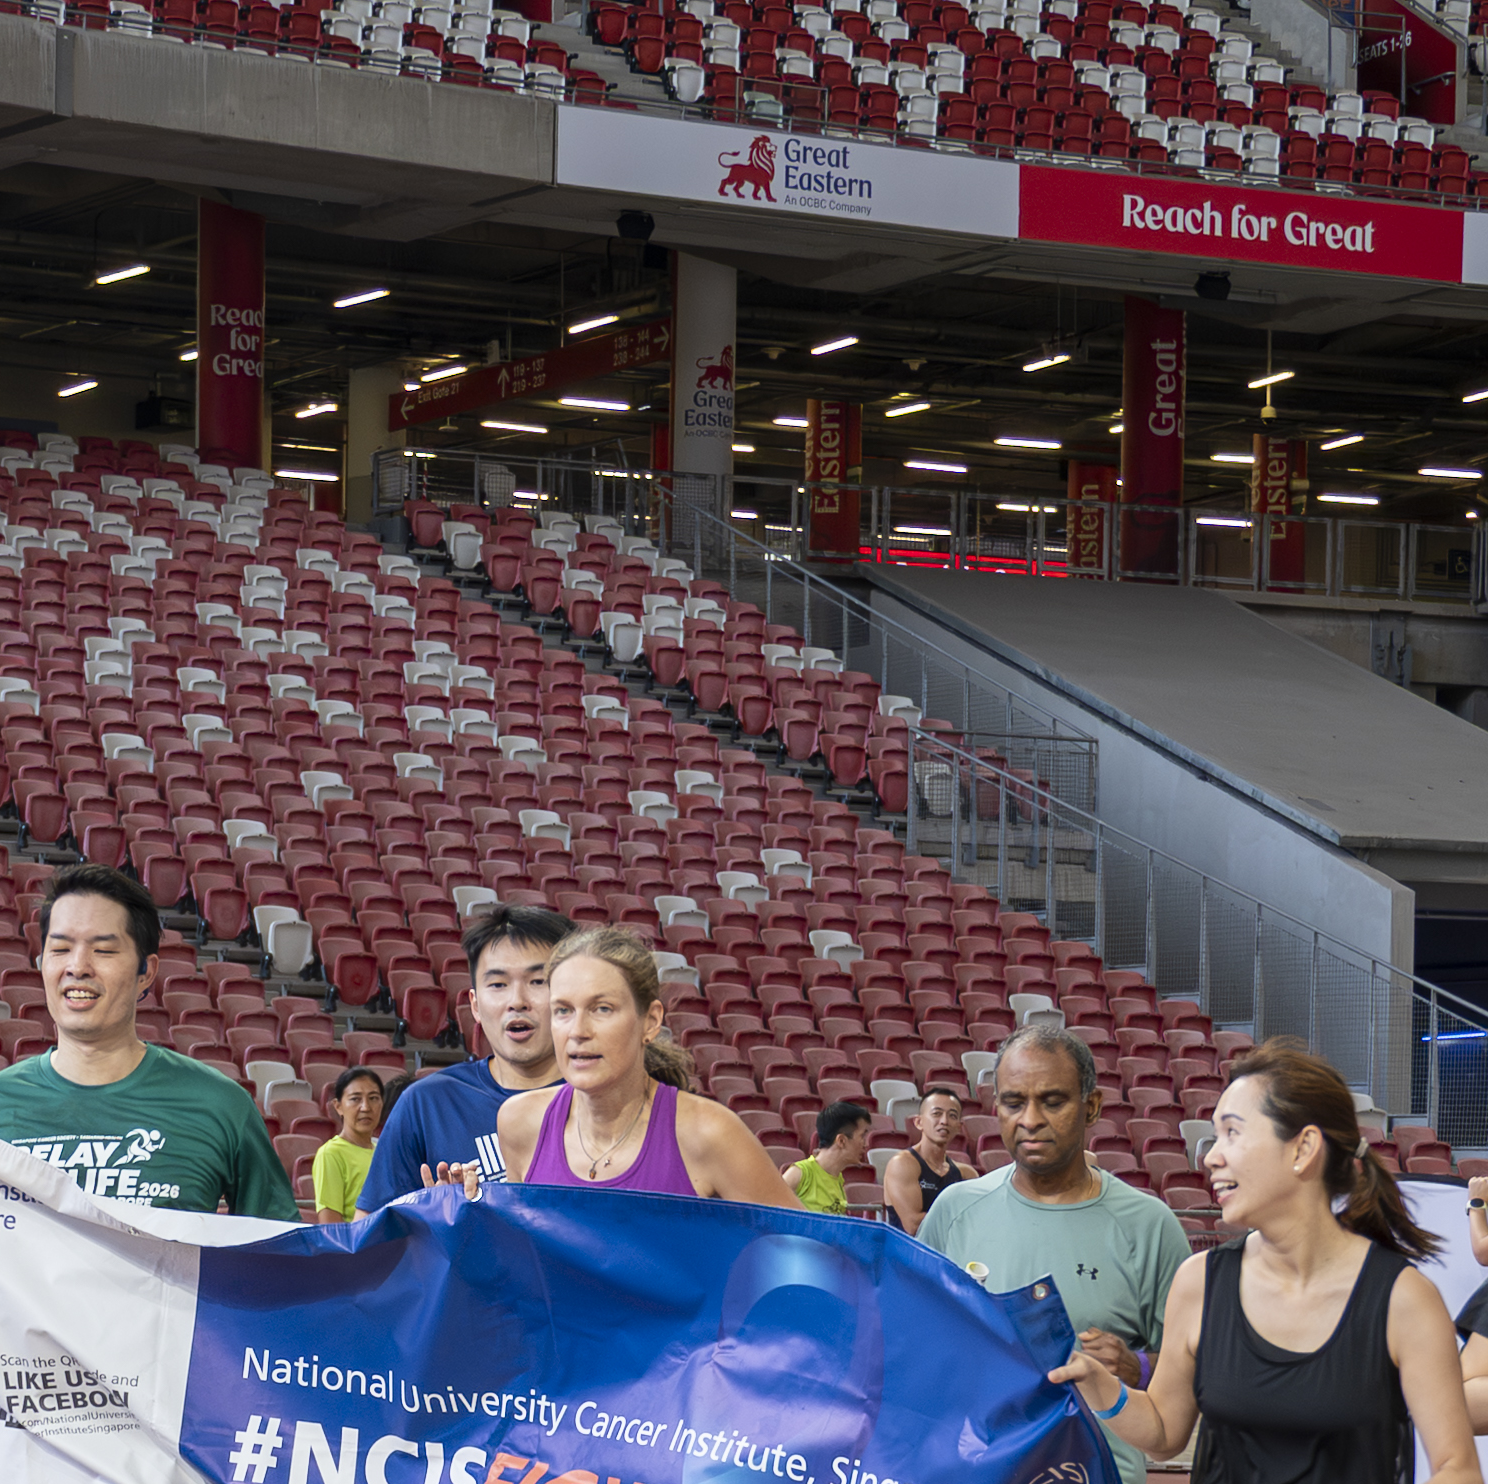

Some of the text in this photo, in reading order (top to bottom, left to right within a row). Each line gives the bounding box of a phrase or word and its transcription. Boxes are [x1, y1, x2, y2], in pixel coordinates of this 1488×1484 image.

[1359, 40, 1388, 64] SEATS
[784, 138, 850, 170] Great
[784, 164, 872, 199] Eastern
[784, 195, 872, 216] An OCBC Company
[1122, 194, 1375, 253] Reach for Great
[230, 327, 261, 351] for
[1148, 338, 1177, 438] Great
[138, 1182, 180, 1199] 2026
[0, 1354, 30, 1367] Scan
[32, 1356, 56, 1369] the
[111, 1375, 140, 1388] and
[3, 1370, 99, 1390] LIKE US
[243, 1346, 393, 1402] National
[401, 1379, 568, 1436] University
[575, 1401, 667, 1448] Cancer
